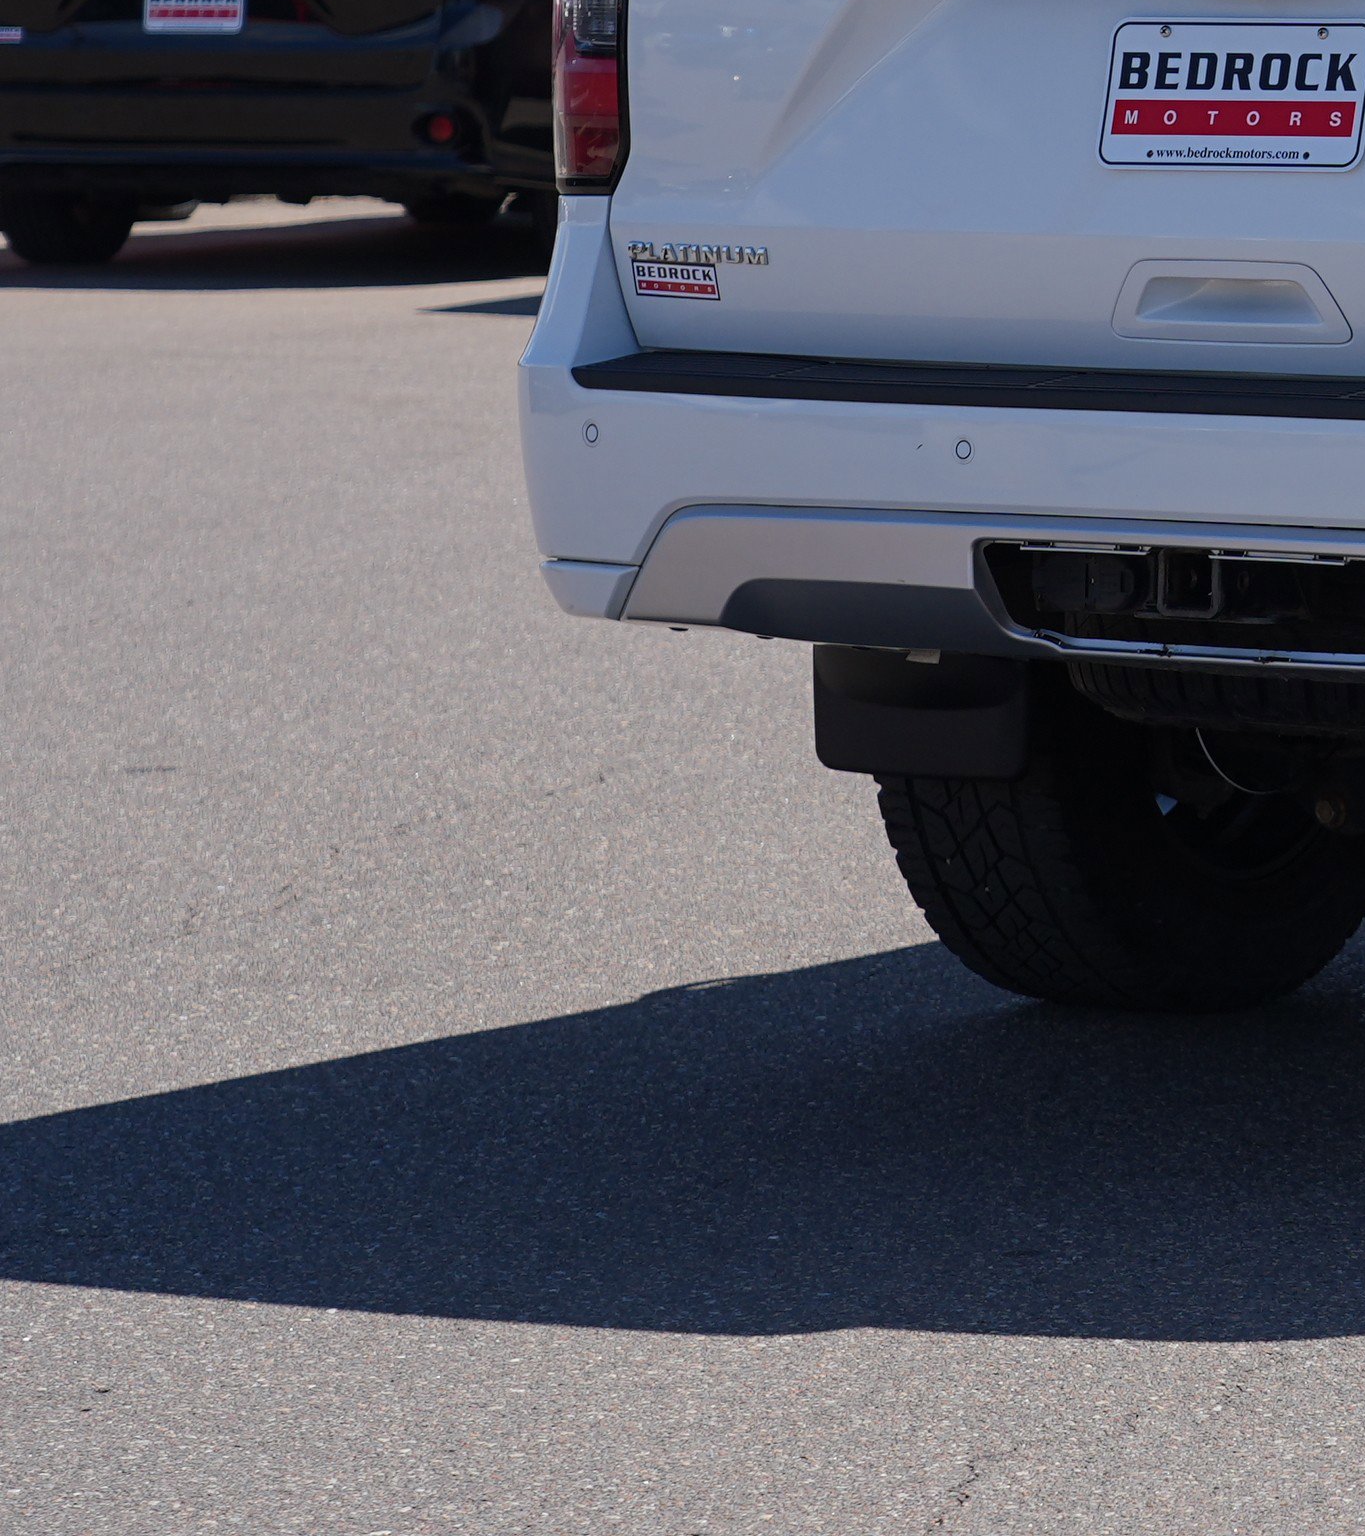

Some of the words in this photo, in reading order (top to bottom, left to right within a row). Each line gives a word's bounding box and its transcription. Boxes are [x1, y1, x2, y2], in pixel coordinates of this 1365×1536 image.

[1118, 52, 1357, 91] BEDROCK
[1124, 109, 1342, 127] MOTORS
[1156, 146, 1300, 160] www.bedrockmotors.com
[627, 240, 770, 265] PLATINUM
[636, 265, 714, 282] BEDROCK
[640, 282, 713, 293] MOTORS
